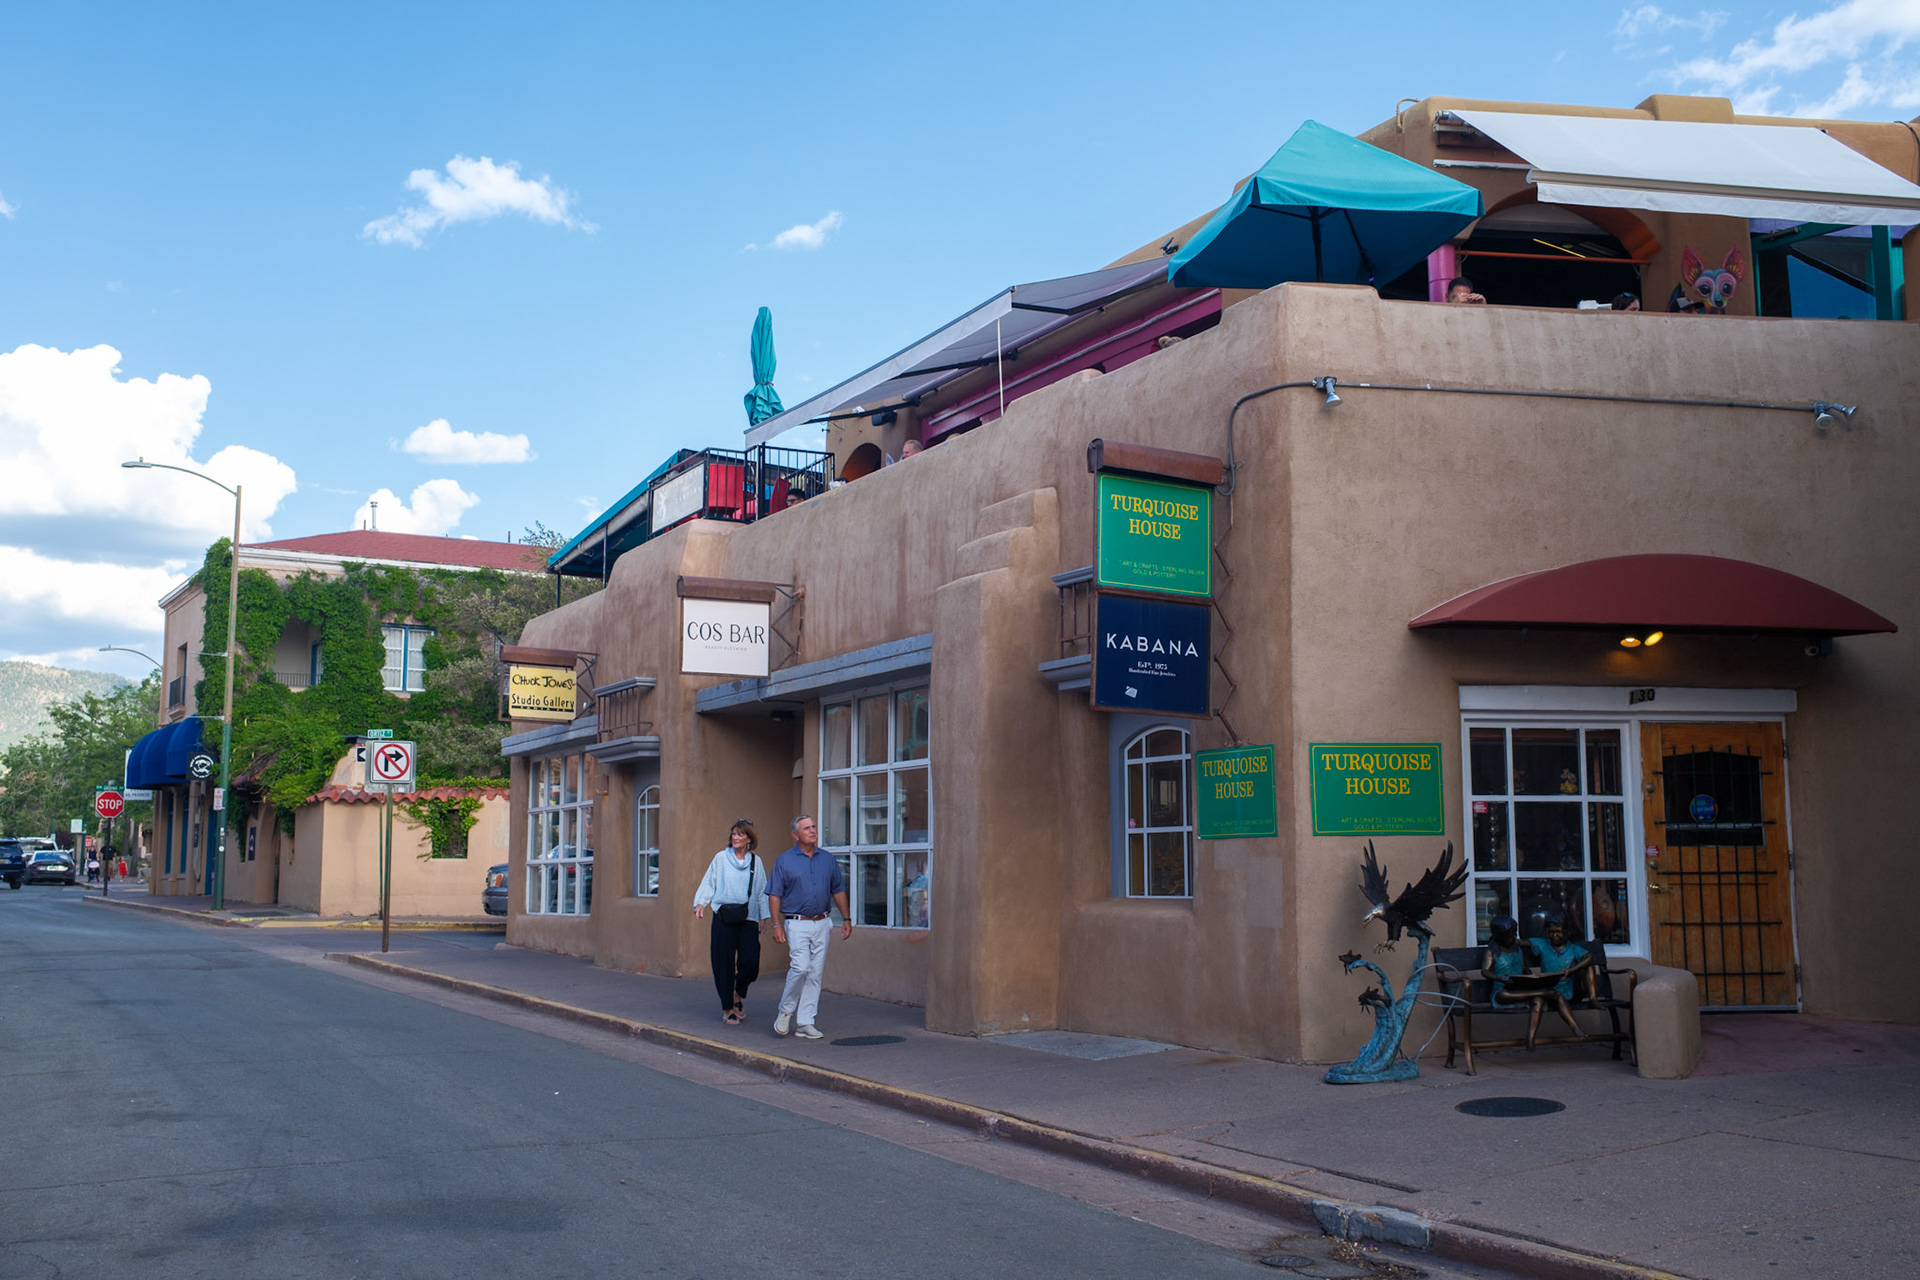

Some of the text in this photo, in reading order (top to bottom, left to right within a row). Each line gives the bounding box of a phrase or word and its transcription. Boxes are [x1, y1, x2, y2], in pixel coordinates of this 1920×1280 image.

[1110, 494, 1199, 520] TURQUOISE
[1129, 518, 1181, 539] HOUSE
[687, 621, 765, 645] COS BAR
[1106, 632, 1199, 658] KABANA
[511, 693, 575, 709] Studio Gallery
[1201, 755, 1268, 778] TURQUOISE
[1321, 753, 1432, 774] TURQUOISE
[1215, 780, 1254, 799] HOUSE
[1345, 777, 1411, 795] HOUSE
[98, 799, 123, 810] STOP
